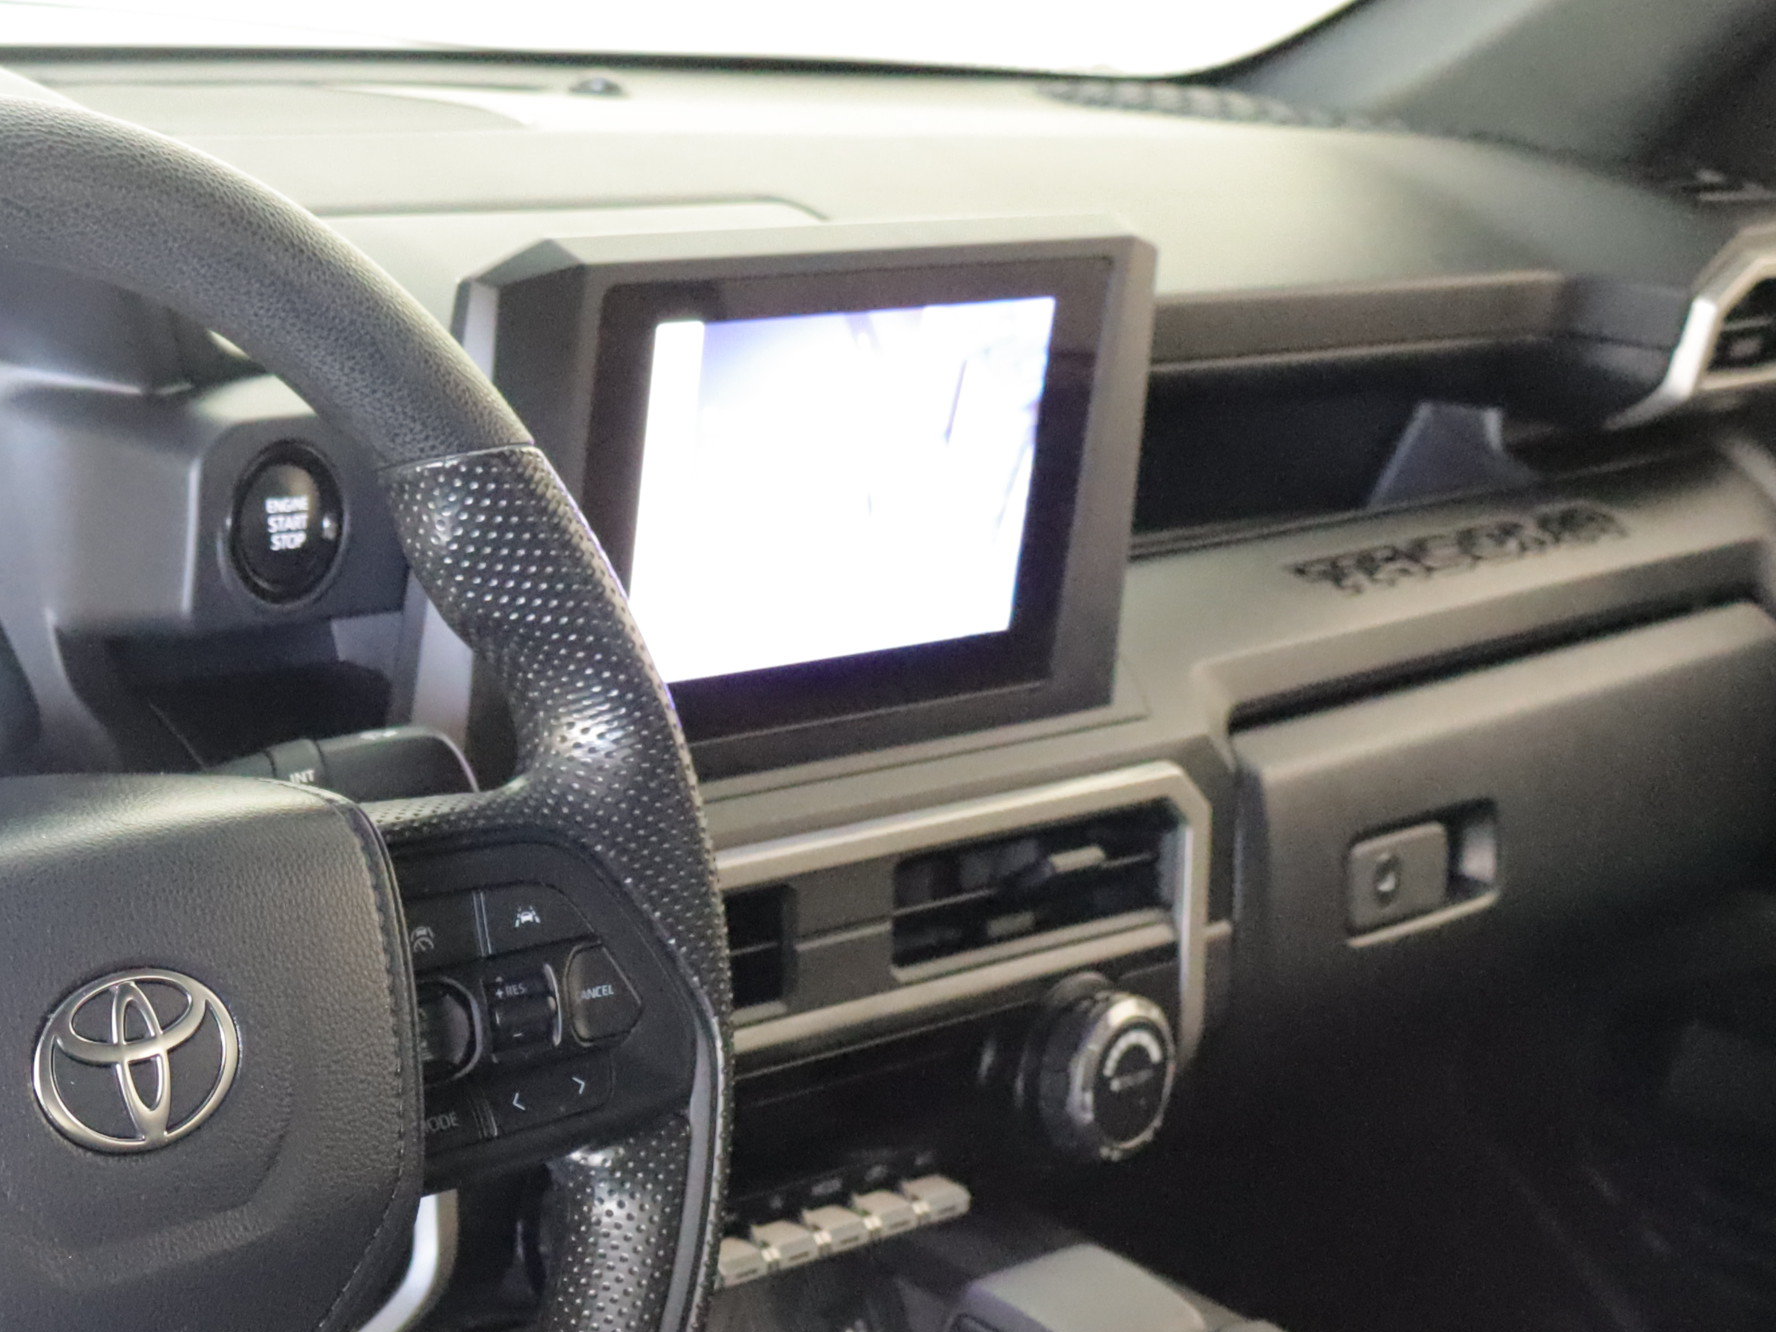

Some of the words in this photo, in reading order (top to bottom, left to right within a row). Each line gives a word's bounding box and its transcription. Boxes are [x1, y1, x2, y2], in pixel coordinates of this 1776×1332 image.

[267, 512, 308, 533] START
[270, 530, 307, 551] STOP
[289, 768, 315, 784] INT
[580, 984, 614, 1000] ANCEL
[425, 1111, 459, 1134] ODE
